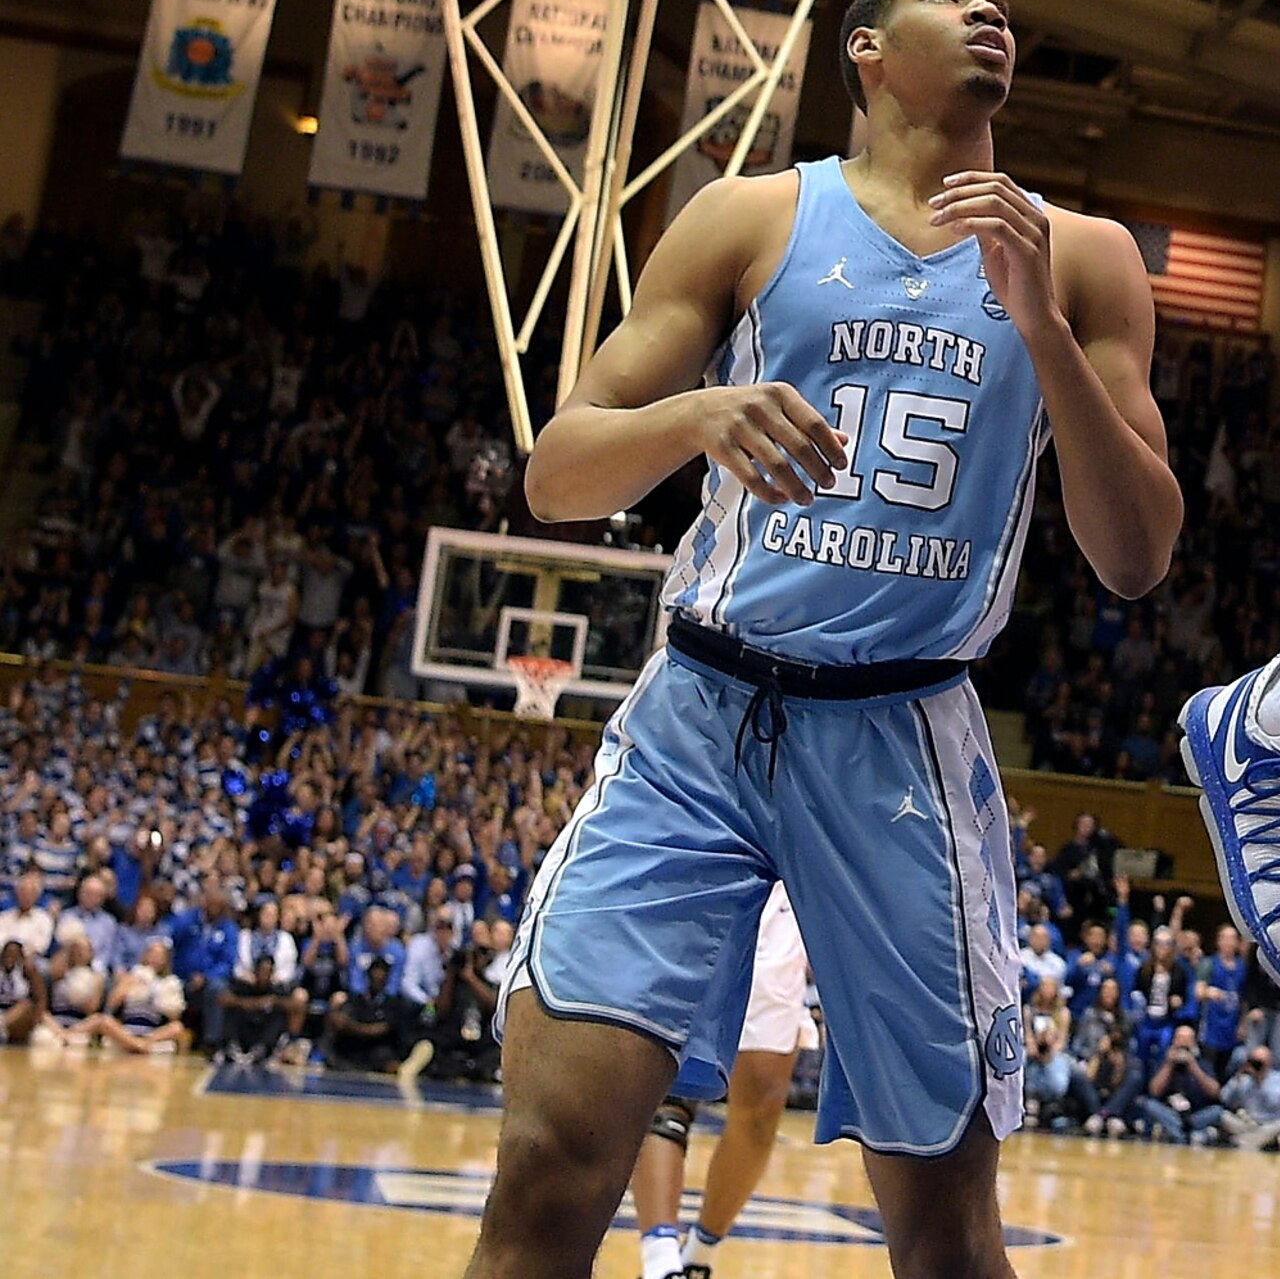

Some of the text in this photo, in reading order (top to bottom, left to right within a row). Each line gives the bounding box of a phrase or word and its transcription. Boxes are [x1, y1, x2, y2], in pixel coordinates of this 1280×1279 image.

[827, 319, 986, 386] NORTH
[813, 383, 971, 512] 15
[763, 509, 973, 581] CAROLINA
